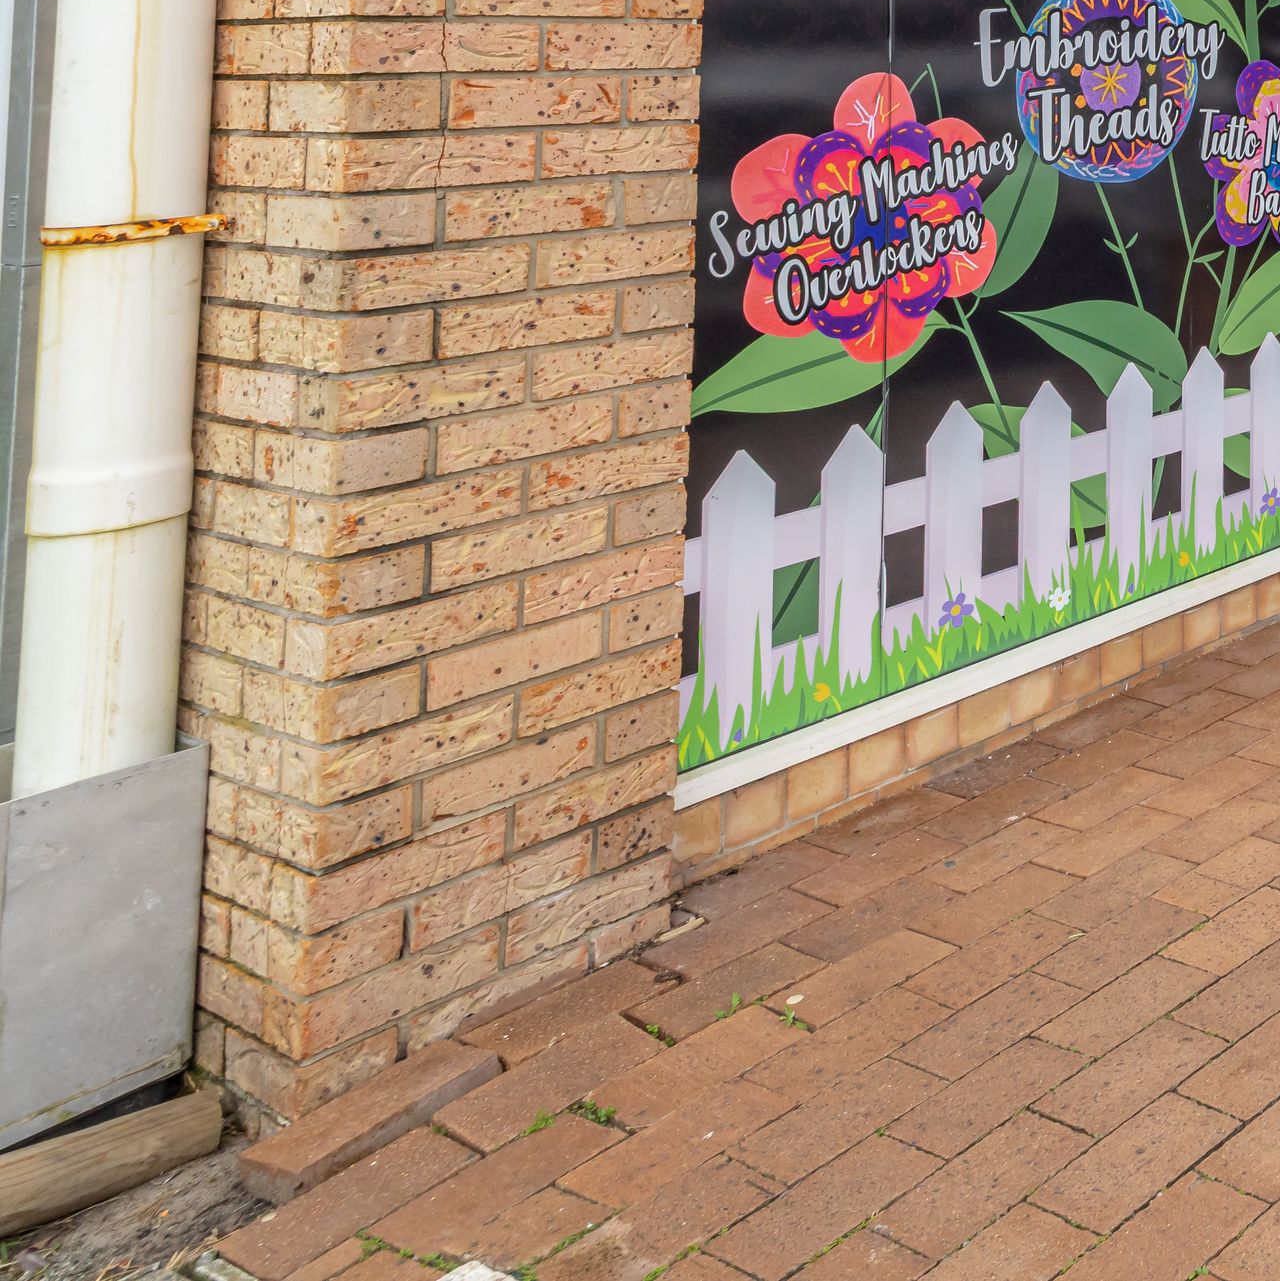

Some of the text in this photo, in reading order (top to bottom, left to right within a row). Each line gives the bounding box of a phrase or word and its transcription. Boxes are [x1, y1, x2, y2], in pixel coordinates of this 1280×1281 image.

[972, 6, 1226, 88] Embroidery
[1197, 108, 1262, 163] Tutto
[707, 134, 1019, 280] Sewing Machines
[773, 211, 985, 325] Overlockers
